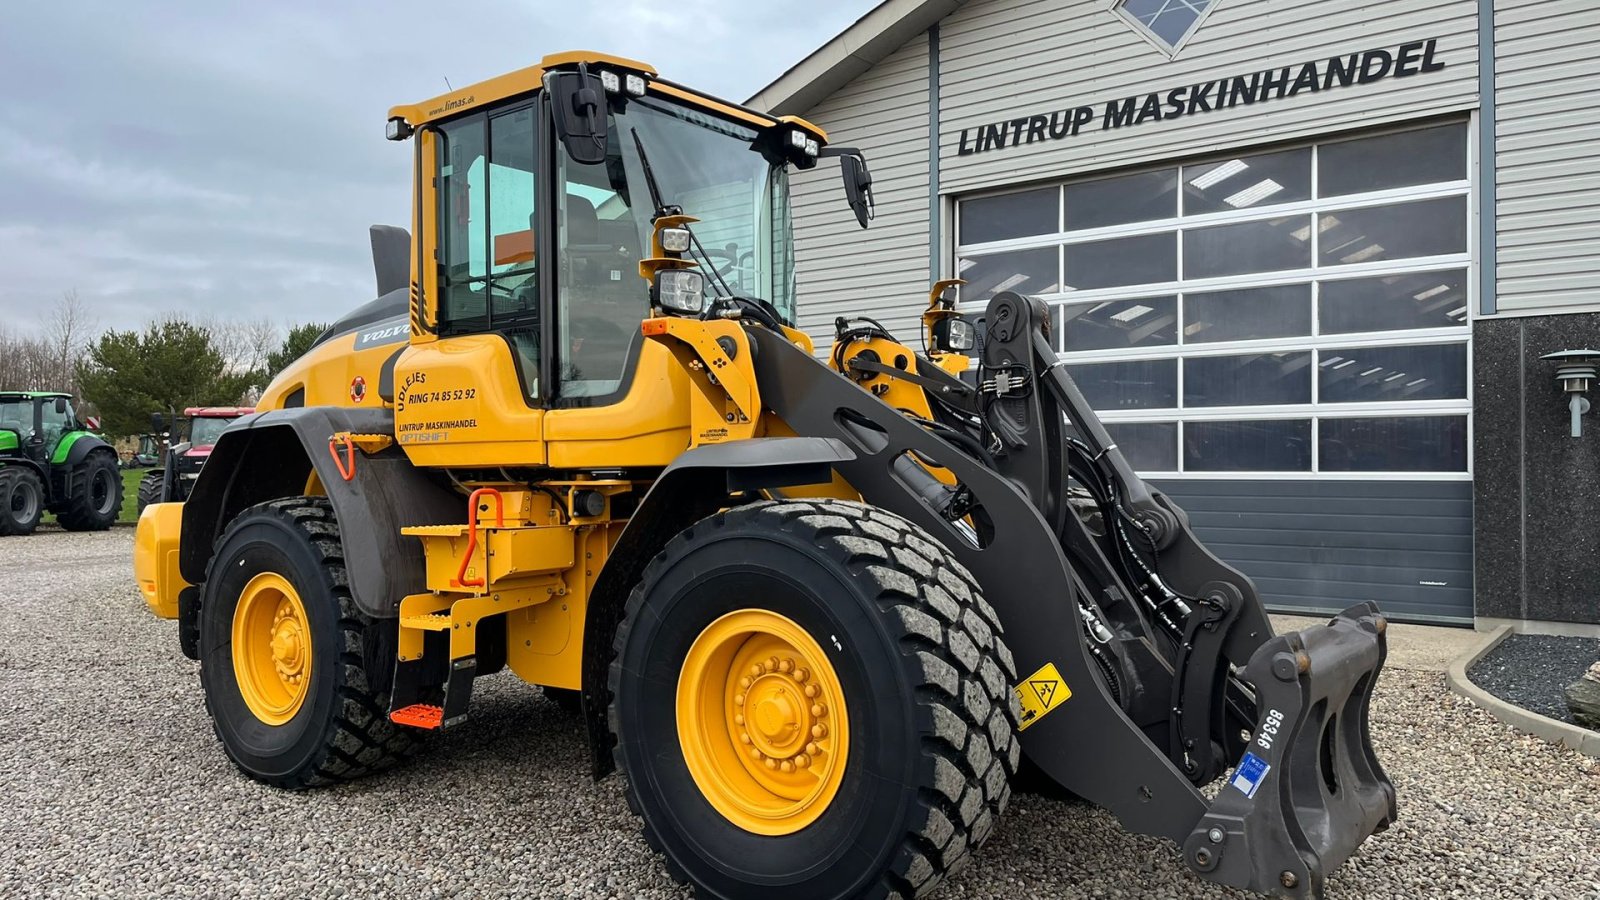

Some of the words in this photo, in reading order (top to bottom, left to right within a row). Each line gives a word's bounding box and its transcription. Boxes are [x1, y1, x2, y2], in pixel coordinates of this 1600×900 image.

[958, 106, 1093, 156] LINTRUP
[1102, 39, 1446, 131] MASKINHANDEL
[398, 372, 426, 412] UDLEJES
[408, 393, 429, 404] RING
[430, 392, 440, 402] 74
[441, 391, 451, 401] 85
[453, 389, 463, 400] 52
[465, 388, 476, 399] 92
[399, 423, 424, 432] LINTRUP
[425, 419, 477, 430] MASKINHANDEL
[400, 432, 449, 442] OPTISHIFT
[1257, 709, 1284, 750] 85346
